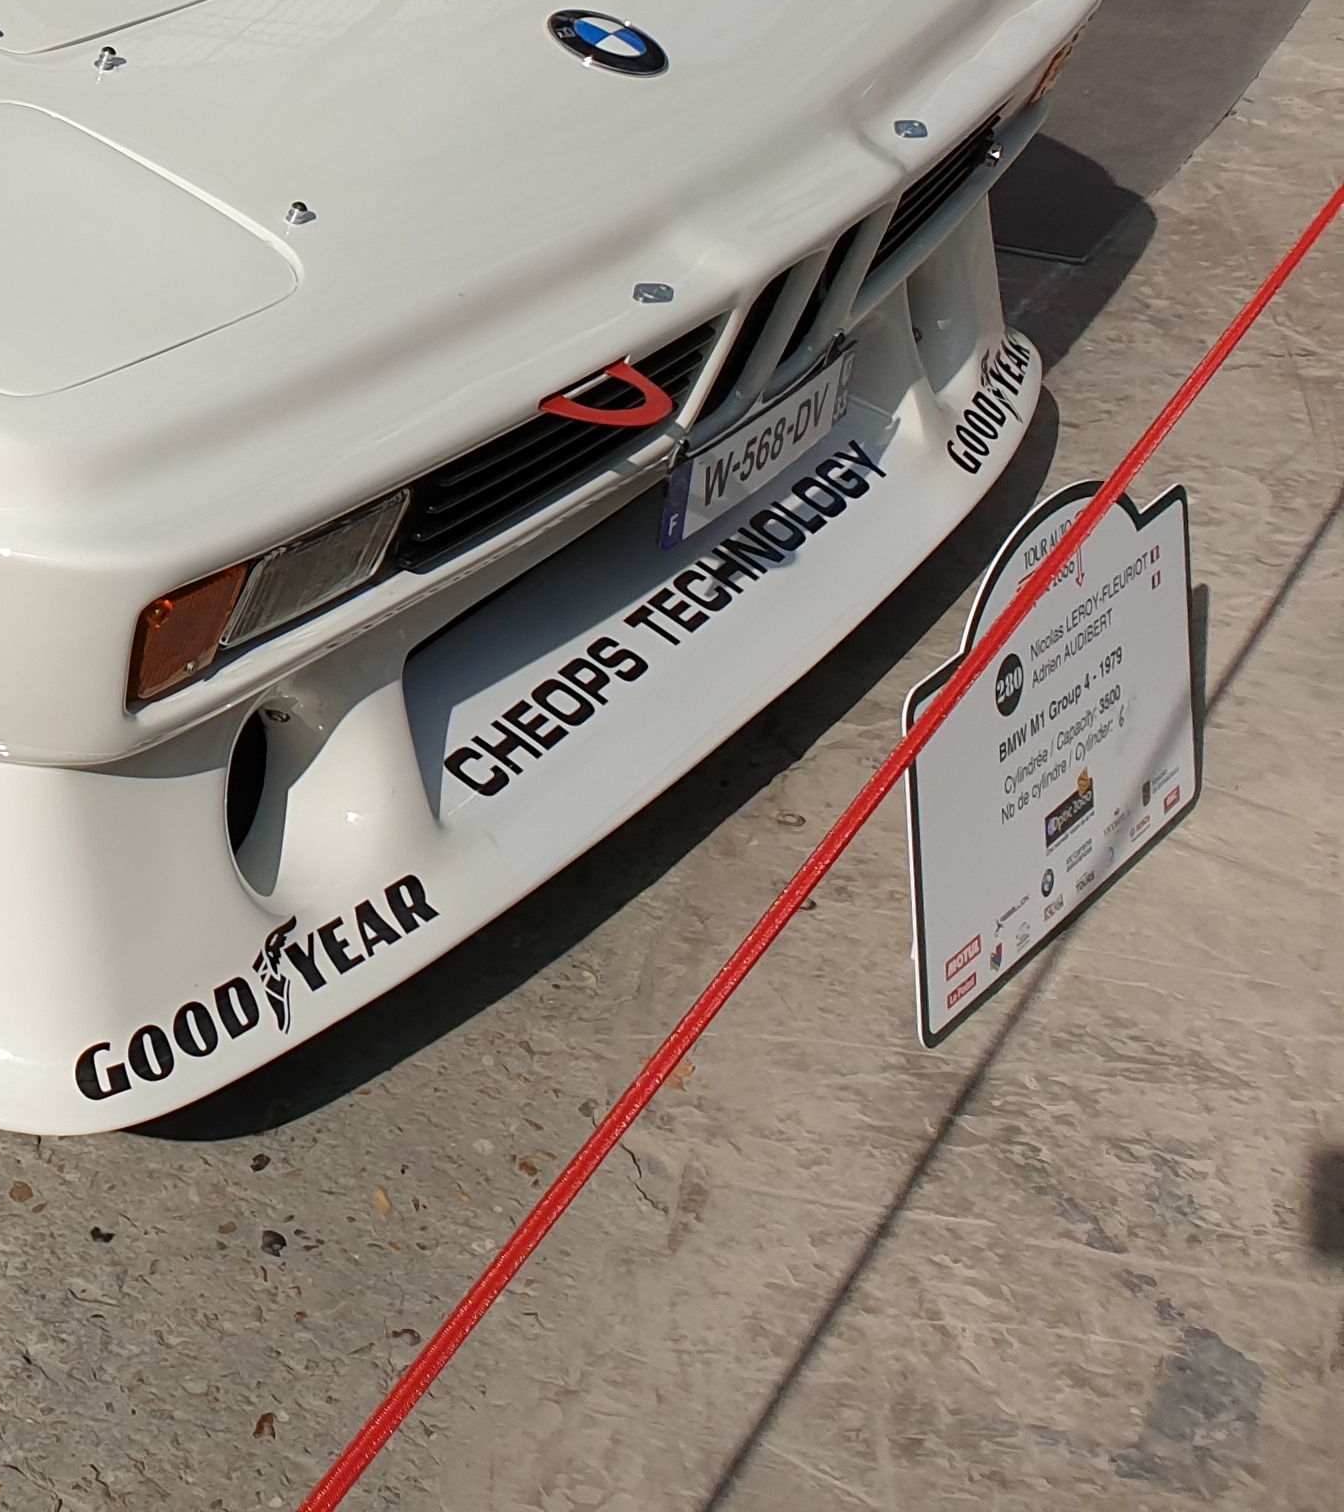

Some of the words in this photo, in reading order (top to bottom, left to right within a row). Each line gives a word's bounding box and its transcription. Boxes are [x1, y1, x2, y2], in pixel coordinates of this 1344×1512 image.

[704, 383, 831, 507] W-568-DV
[947, 338, 1031, 475] GOODYEAR
[623, 439, 888, 648] TECHNOLOGY
[668, 513, 679, 537] F
[1023, 540, 1049, 570] TOUR
[1029, 624, 1065, 662] Nicolas
[1065, 551, 1150, 633] LEROY-FLEURIOT
[1031, 652, 1062, 689] Adrien
[1063, 607, 1114, 663] AUDIBERT
[444, 635, 650, 797] CHEOPS
[995, 666, 1023, 704] 280
[999, 723, 1028, 764] BMW
[1030, 709, 1046, 738] M1
[1048, 683, 1083, 721] Group
[1083, 672, 1091, 690] 4
[1099, 645, 1123, 679] 1979
[1003, 748, 1049, 795] Cylindrée
[1098, 684, 1121, 716] 3500
[1000, 801, 1016, 826] Nb
[1017, 789, 1030, 812] de
[1031, 761, 1067, 804] cylindre
[75, 875, 441, 1100] GOODYEAR
